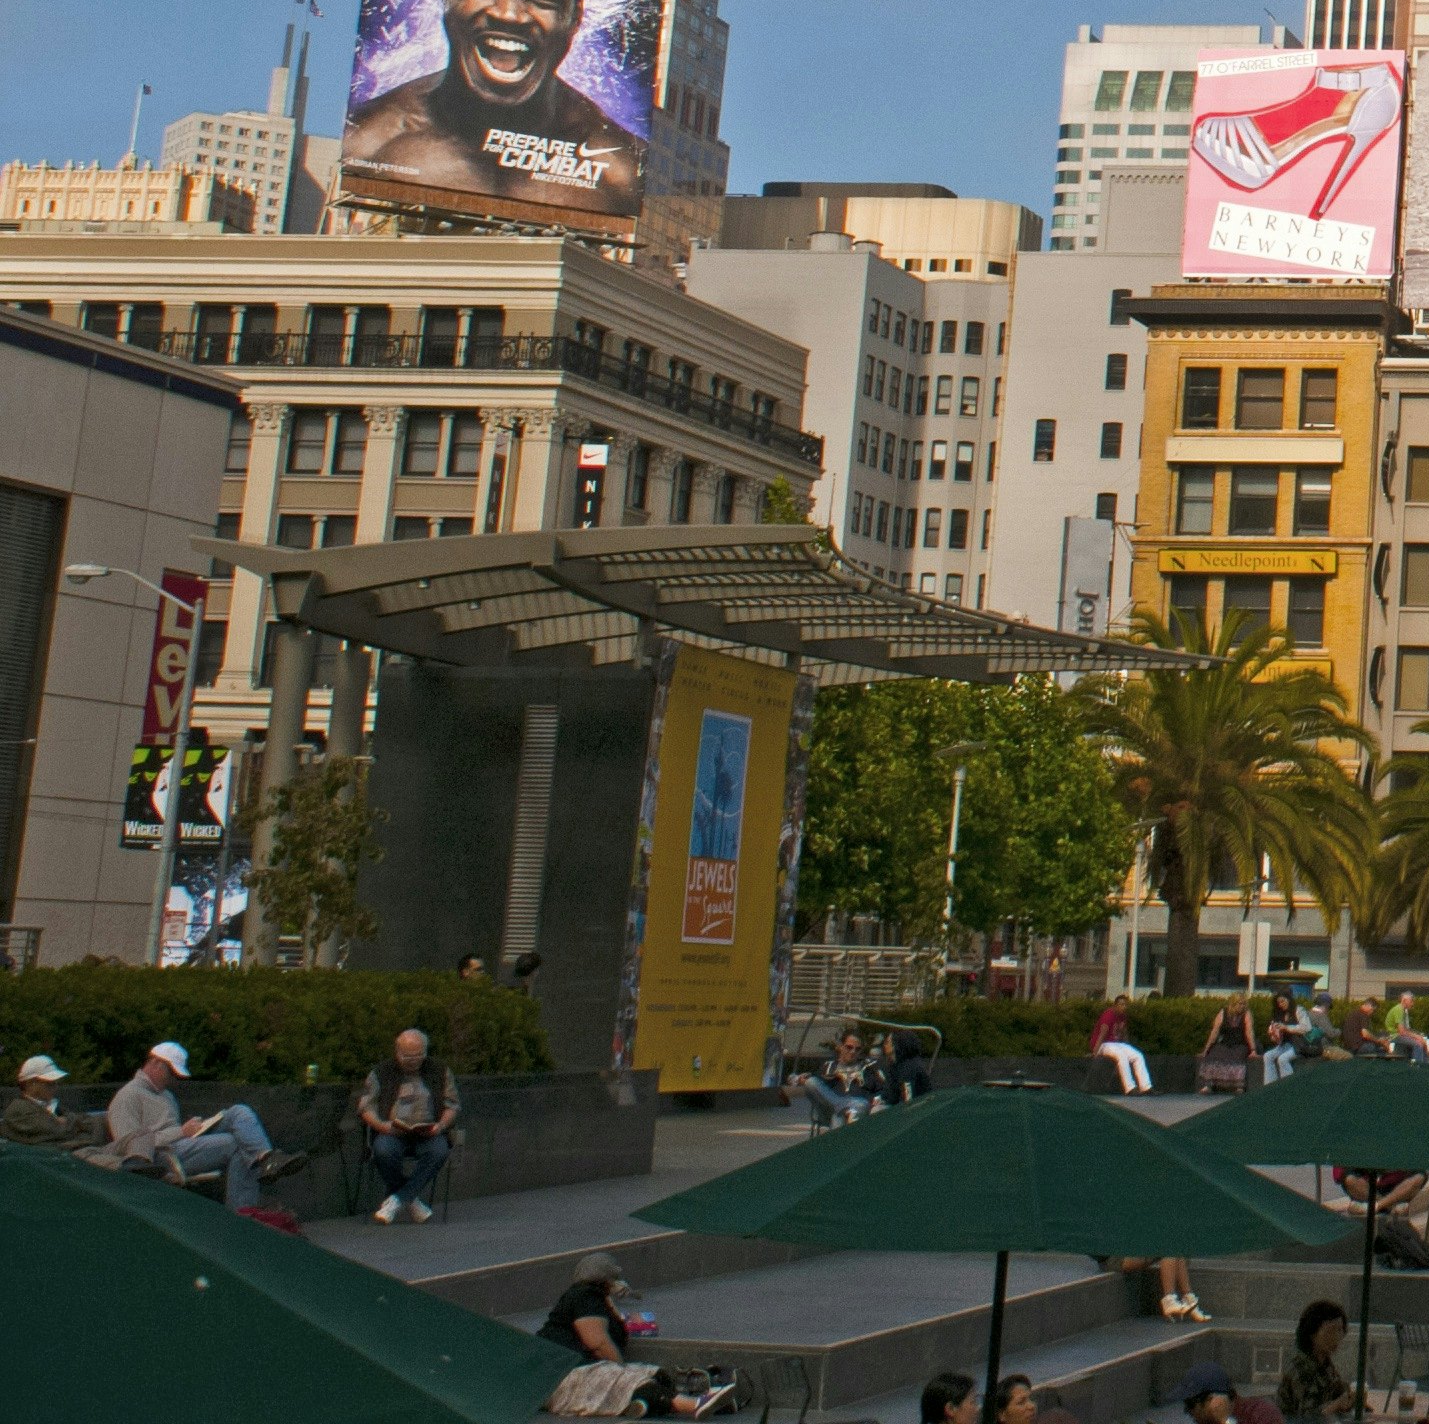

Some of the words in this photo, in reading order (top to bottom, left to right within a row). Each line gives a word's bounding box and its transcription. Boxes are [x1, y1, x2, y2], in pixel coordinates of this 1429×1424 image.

[1200, 64, 1214, 75] 77
[1276, 53, 1315, 68] STREET
[484, 128, 577, 157] PREPARE
[499, 147, 610, 181] COMBAT
[1219, 207, 1370, 246] BARNEYS
[688, 860, 736, 893] JEWELS
